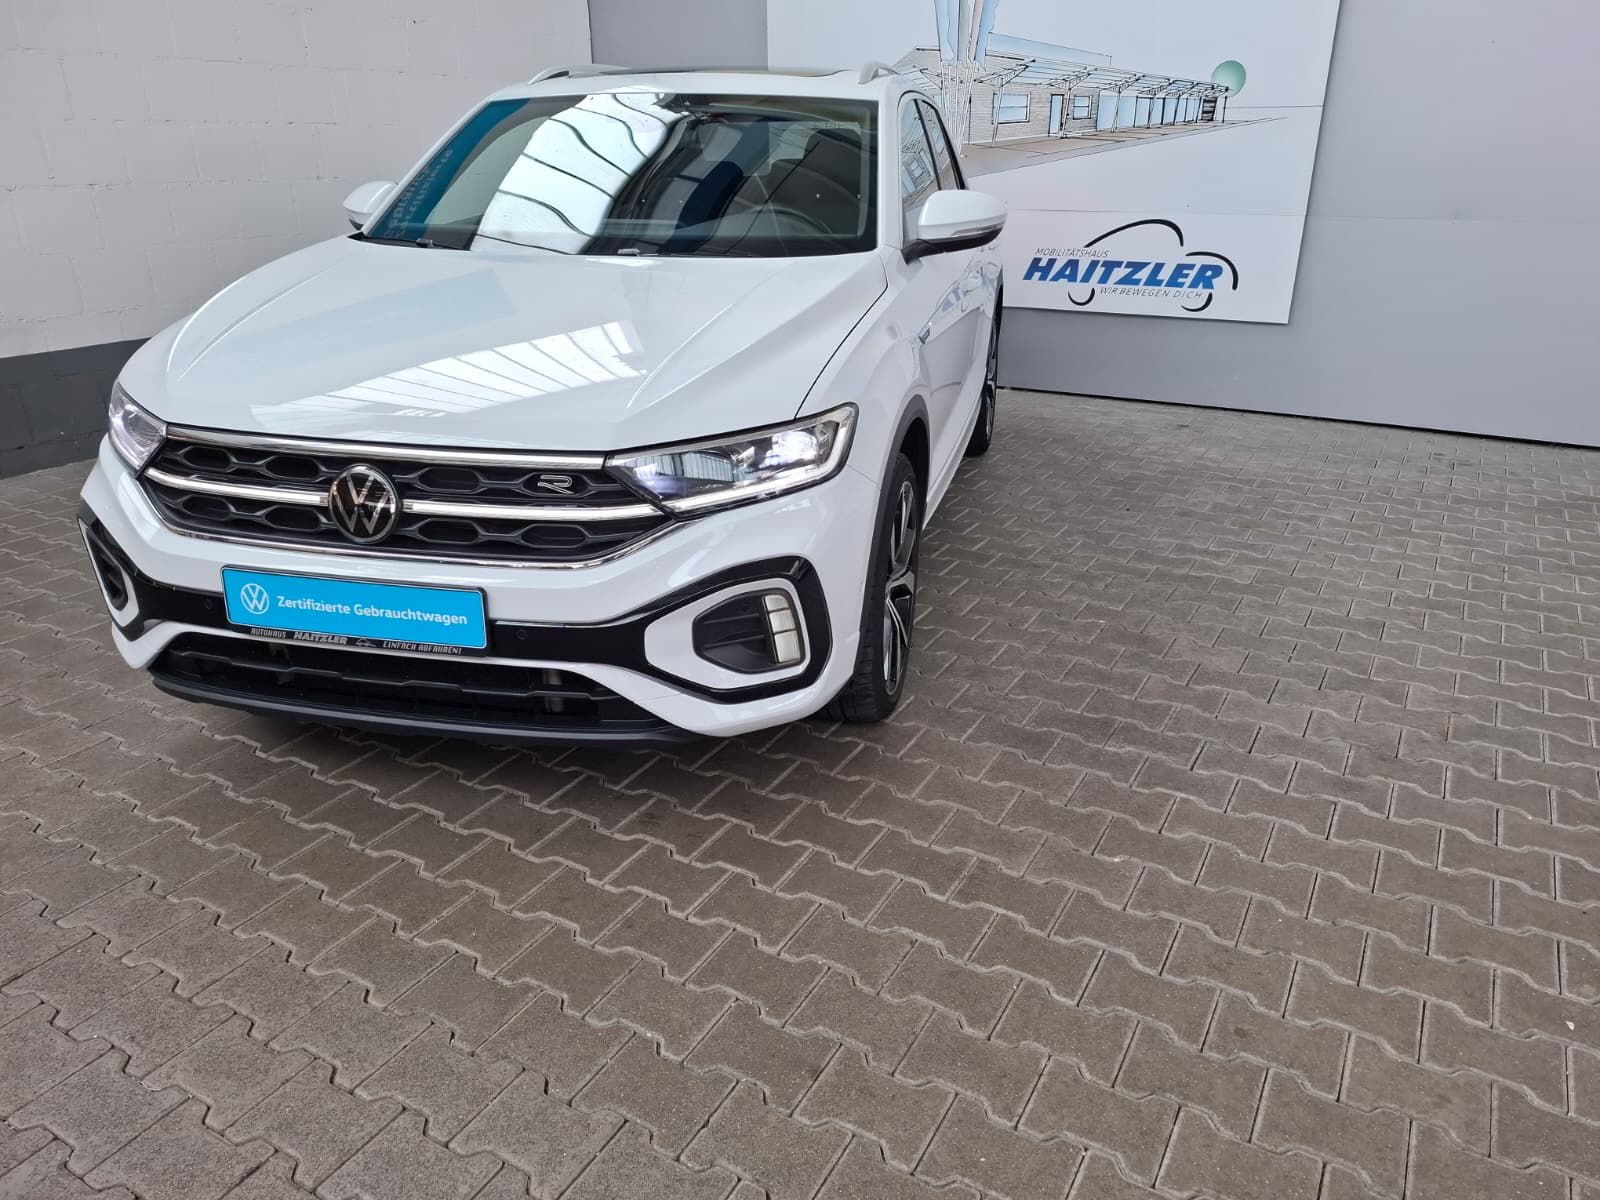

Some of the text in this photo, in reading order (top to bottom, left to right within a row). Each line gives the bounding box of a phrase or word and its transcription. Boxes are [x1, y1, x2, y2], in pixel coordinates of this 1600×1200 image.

[1023, 257, 1223, 290] HAITZLER
[1100, 286, 1202, 299] WIR BEWEGEN DICH
[276, 595, 468, 627] Zertifizierte Gebrauchtwagen
[250, 627, 348, 645] AUTOHAUS HAITZLER
[383, 640, 463, 655] EINFACH ABFAHREN!
